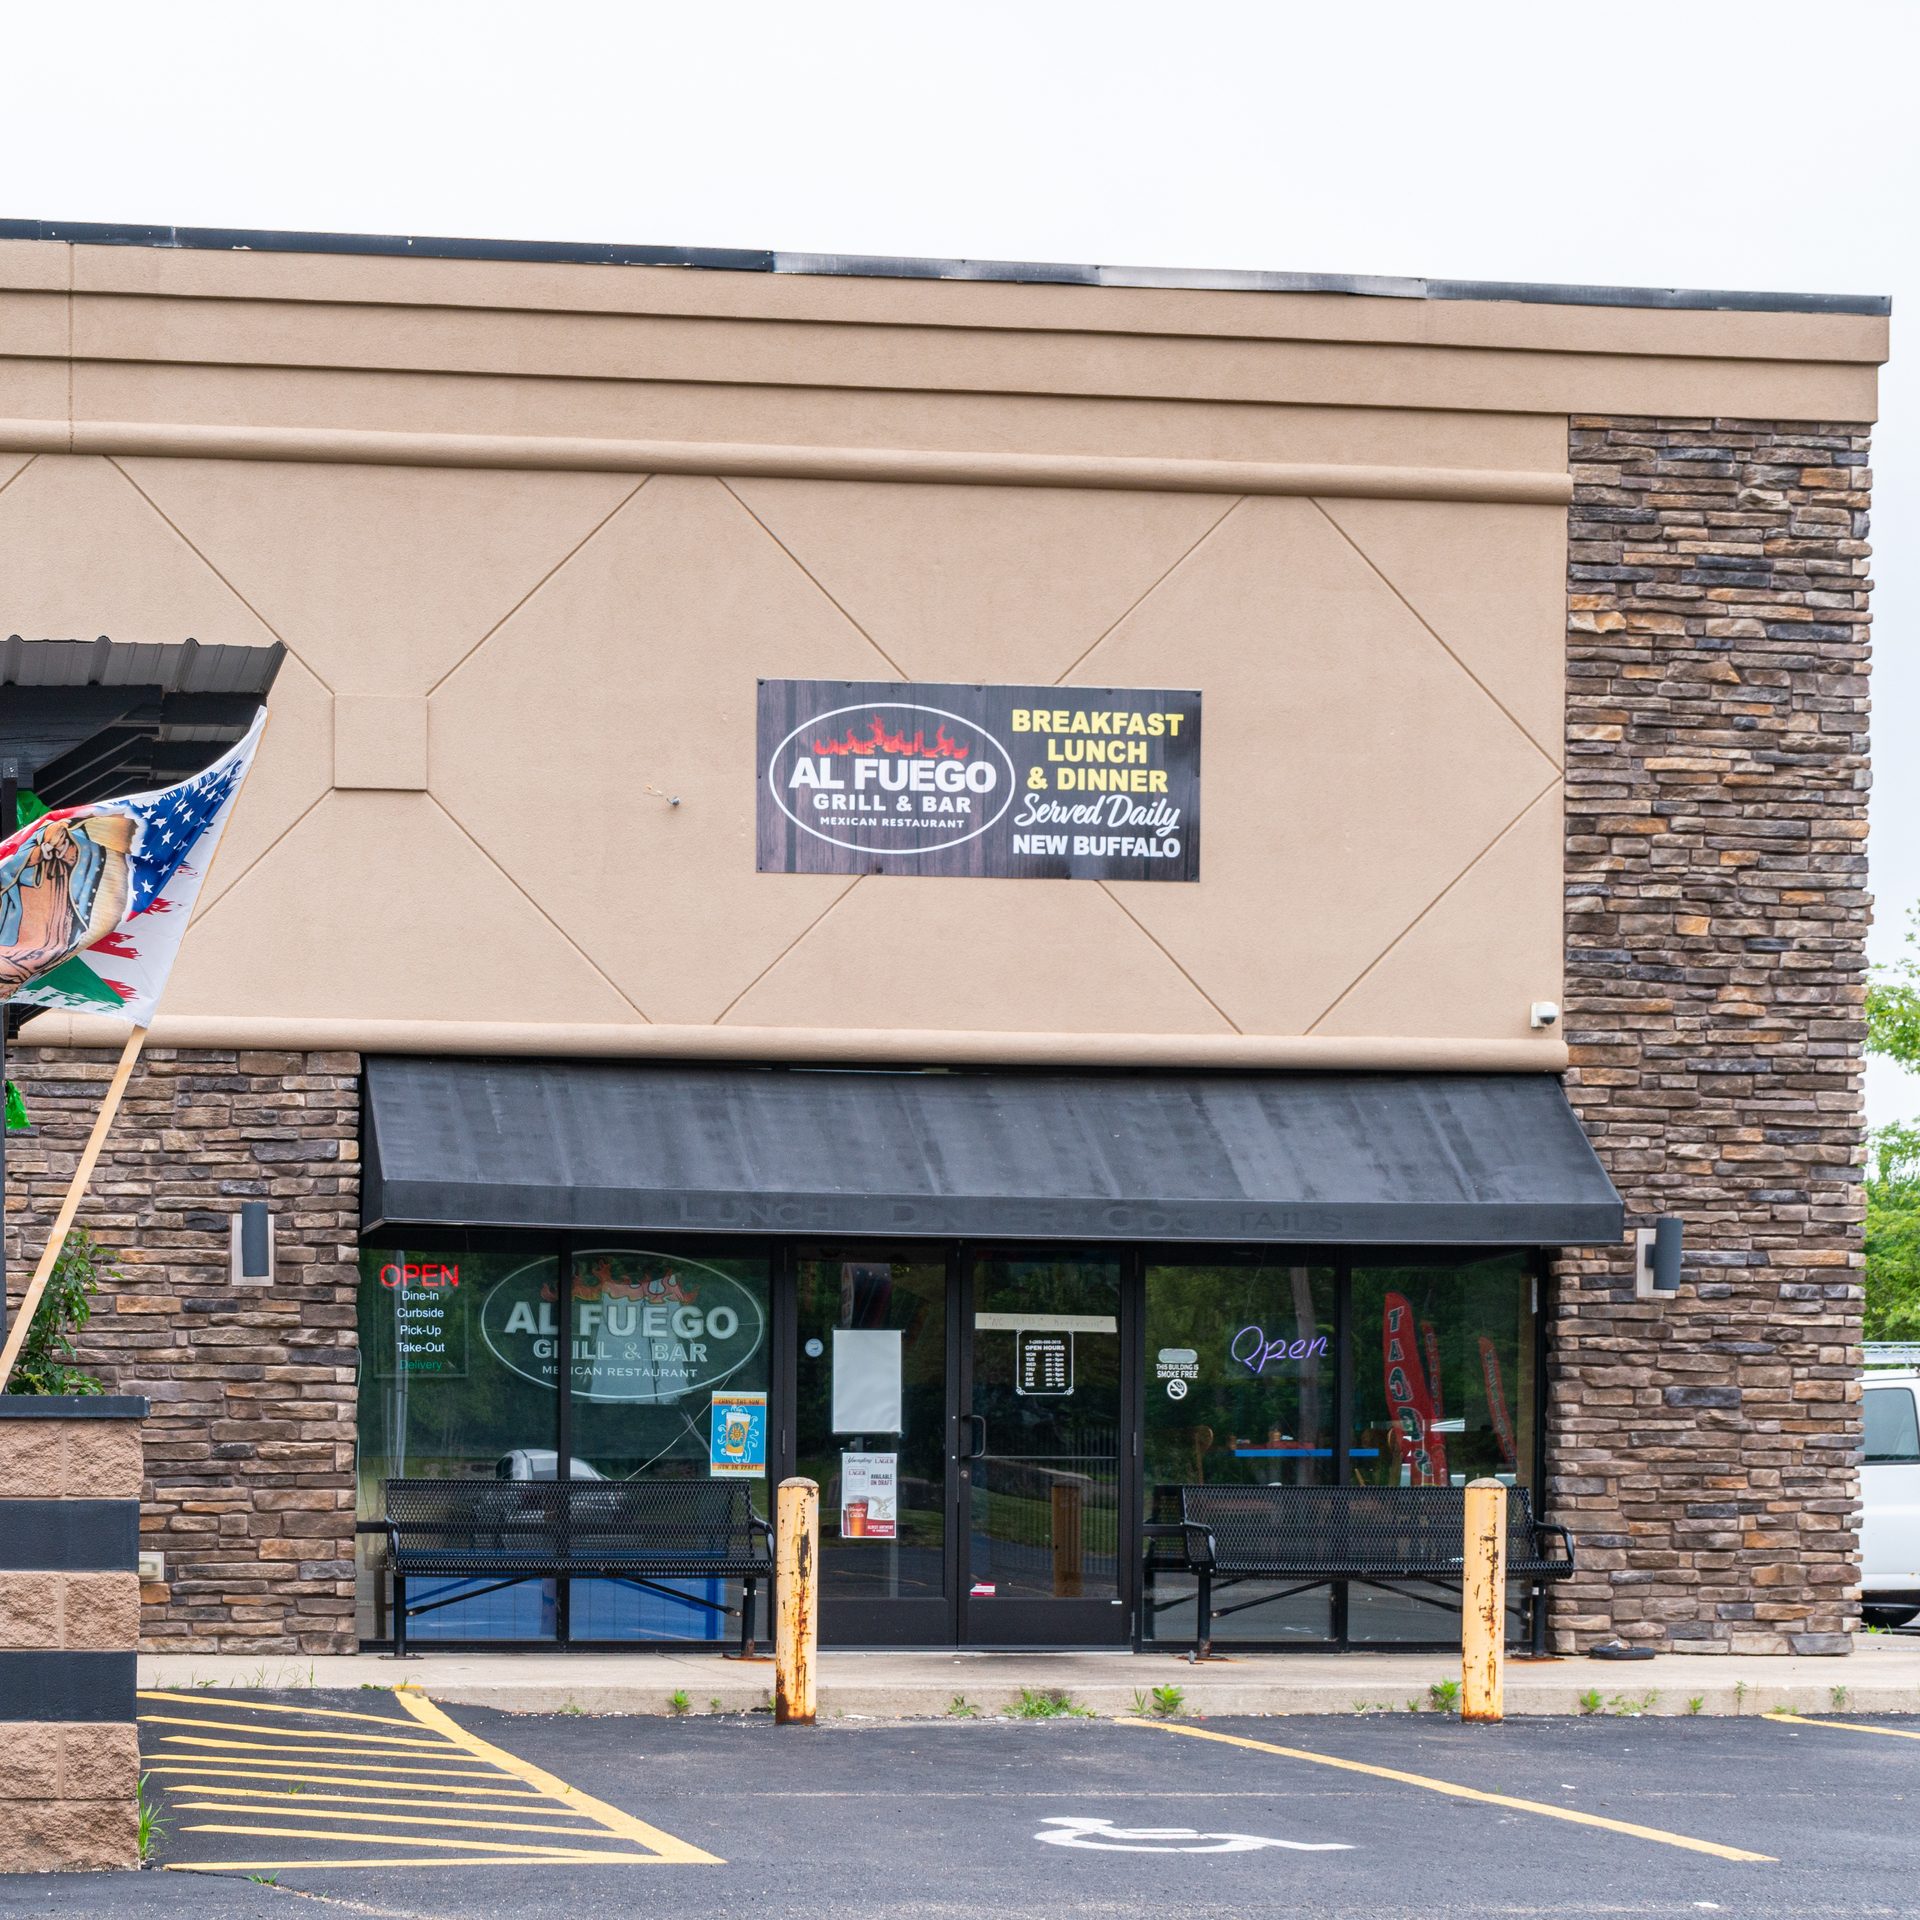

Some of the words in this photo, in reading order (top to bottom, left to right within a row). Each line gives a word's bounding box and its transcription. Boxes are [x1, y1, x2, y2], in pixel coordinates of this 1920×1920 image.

[1011, 709, 1185, 737] BREAKFAST
[1047, 738, 1148, 764] LUNCH
[788, 757, 845, 790] AL
[853, 759, 997, 794] FUEGO
[1026, 767, 1048, 790] &
[1056, 767, 1169, 793] DINNER
[812, 794, 887, 812] GRILL
[895, 796, 913, 812] &
[922, 796, 972, 814] BAR
[1014, 793, 1106, 826] Served
[1104, 795, 1181, 837] Daily
[820, 816, 878, 827] MEXICAN
[881, 818, 965, 829] RESTAURANT
[1012, 834, 1070, 856] NEW
[1073, 836, 1181, 859] BUFFALO
[380, 1263, 459, 1288] OPEN
[401, 1290, 440, 1301] Dine-In
[396, 1307, 445, 1318] Curbside
[504, 1301, 559, 1335] AL
[580, 1304, 739, 1340] FUEGO
[400, 1325, 442, 1338] Pick-Up
[396, 1342, 446, 1353] Take-Out
[533, 1338, 612, 1360] GILL
[623, 1342, 642, 1361] &
[652, 1343, 708, 1362] BAR
[1230, 1325, 1328, 1374] Open
[399, 1359, 443, 1372] Delivery
[541, 1364, 603, 1377] MEICAN
[607, 1366, 698, 1378] RESTAURANT
